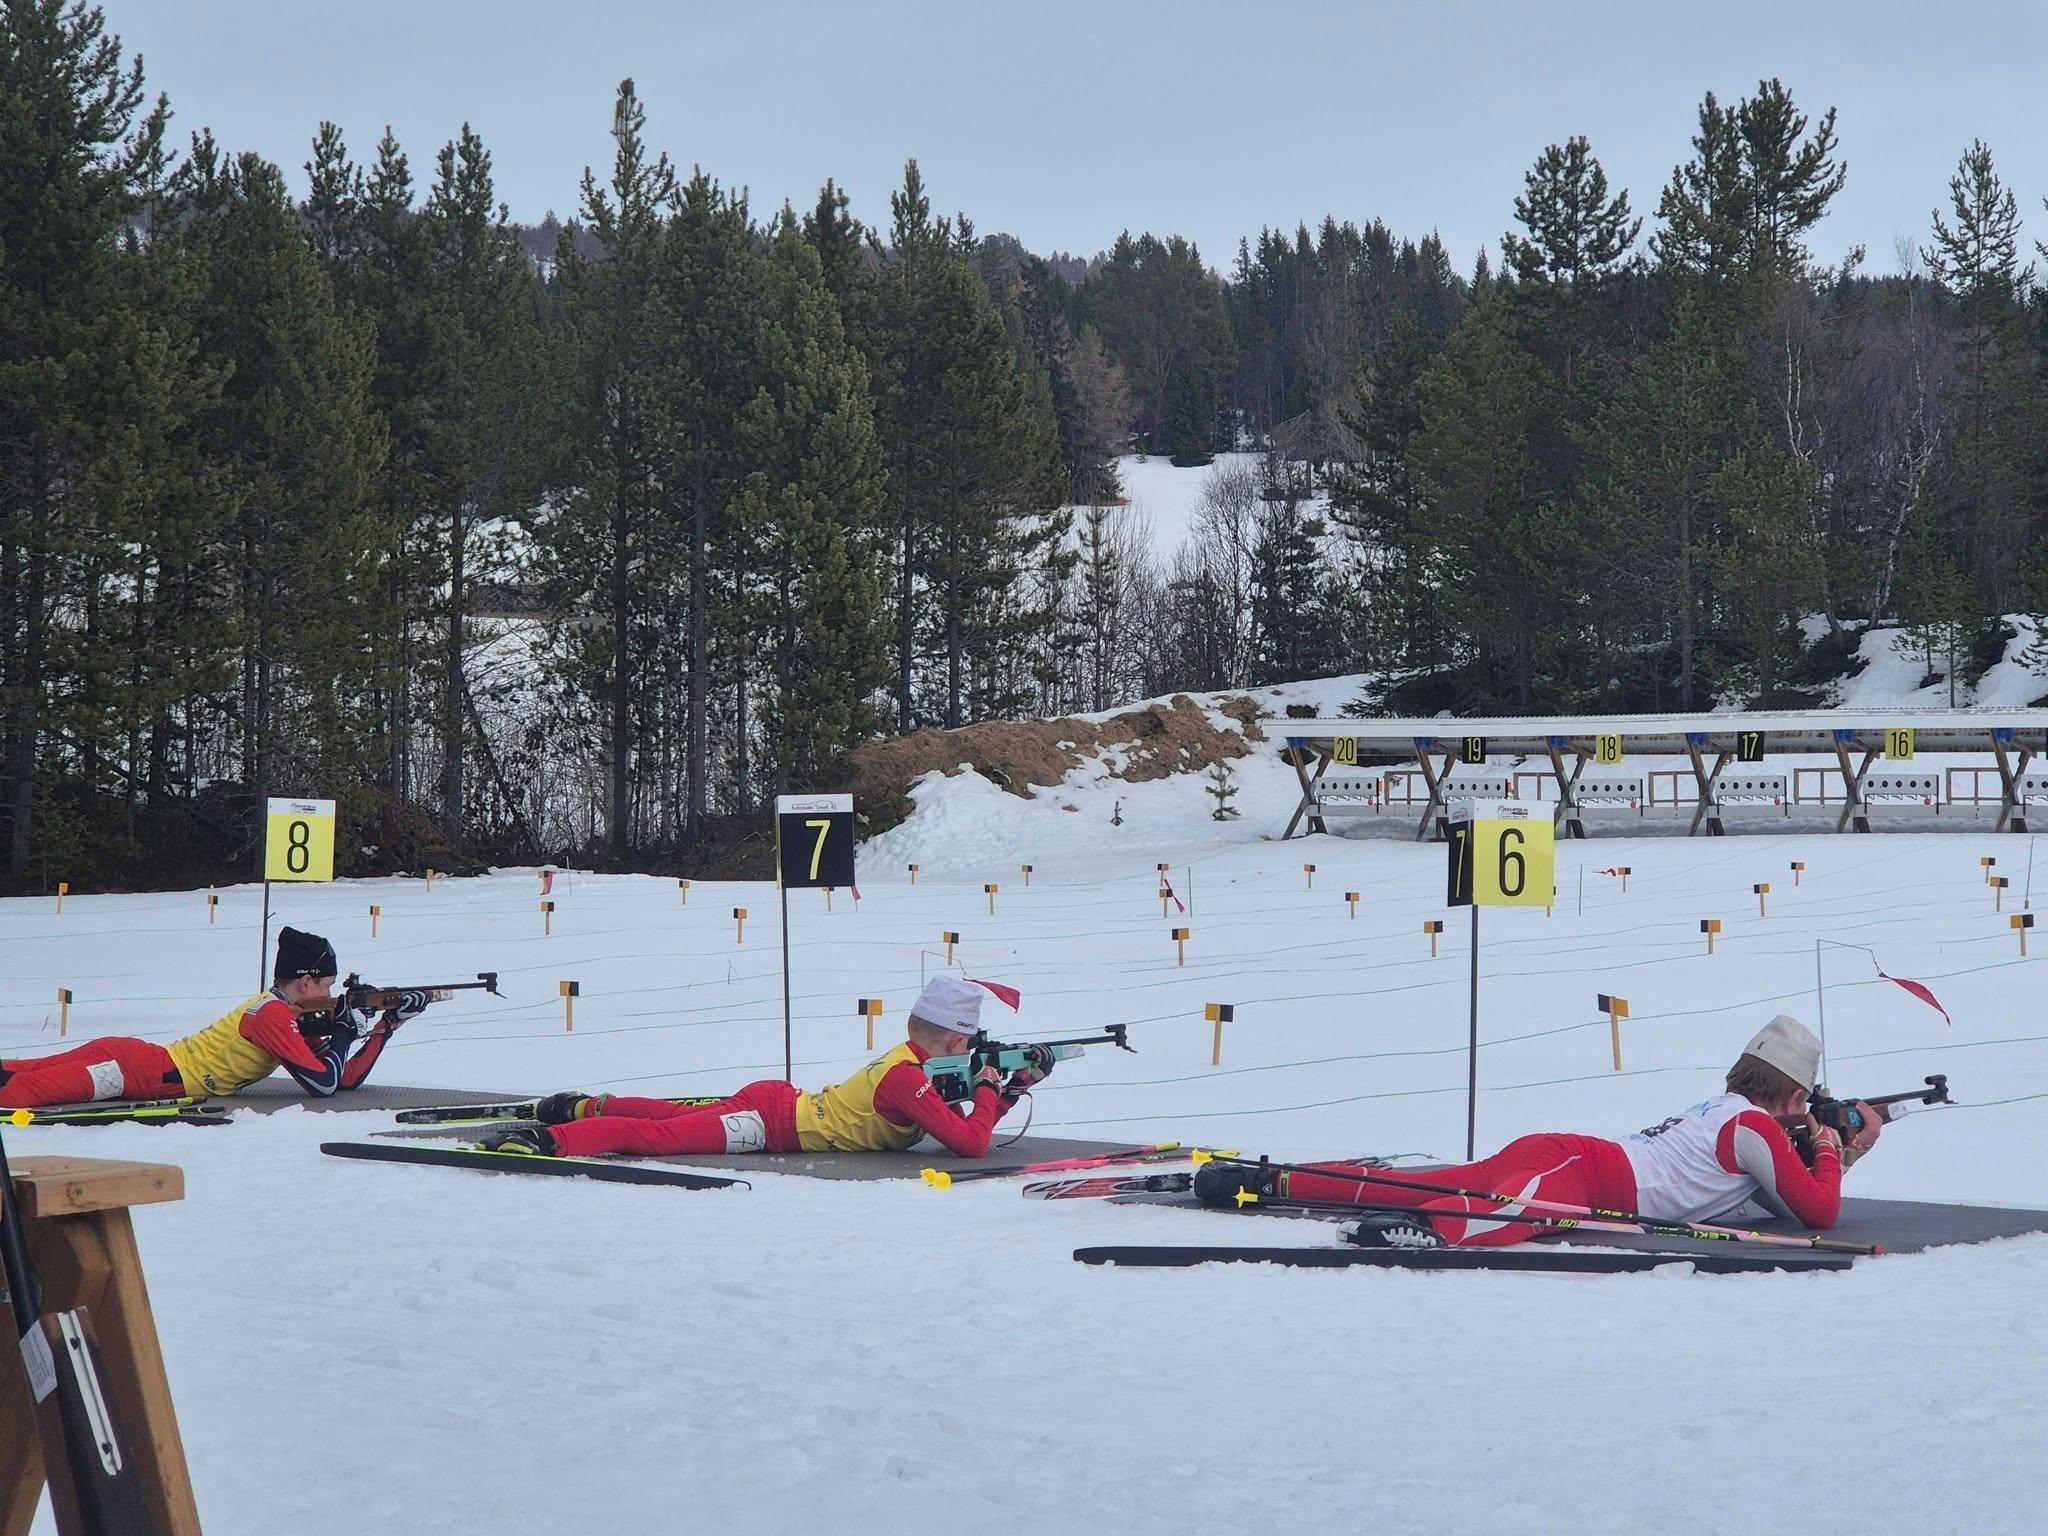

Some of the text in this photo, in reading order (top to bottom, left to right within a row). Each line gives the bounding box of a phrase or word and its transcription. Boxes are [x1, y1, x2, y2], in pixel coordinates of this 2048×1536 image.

[1337, 737, 1354, 762] 20
[1466, 737, 1481, 762] 19
[1601, 736, 1616, 761] 18
[1742, 732, 1759, 760] 17
[1891, 731, 1909, 757] 16
[287, 820, 310, 874] 8
[805, 819, 831, 880] 7
[1456, 829, 1466, 898] 7
[1499, 827, 1526, 897] 6
[726, 1114, 758, 1148] 67
[1694, 1229, 1730, 1242] LEKI
